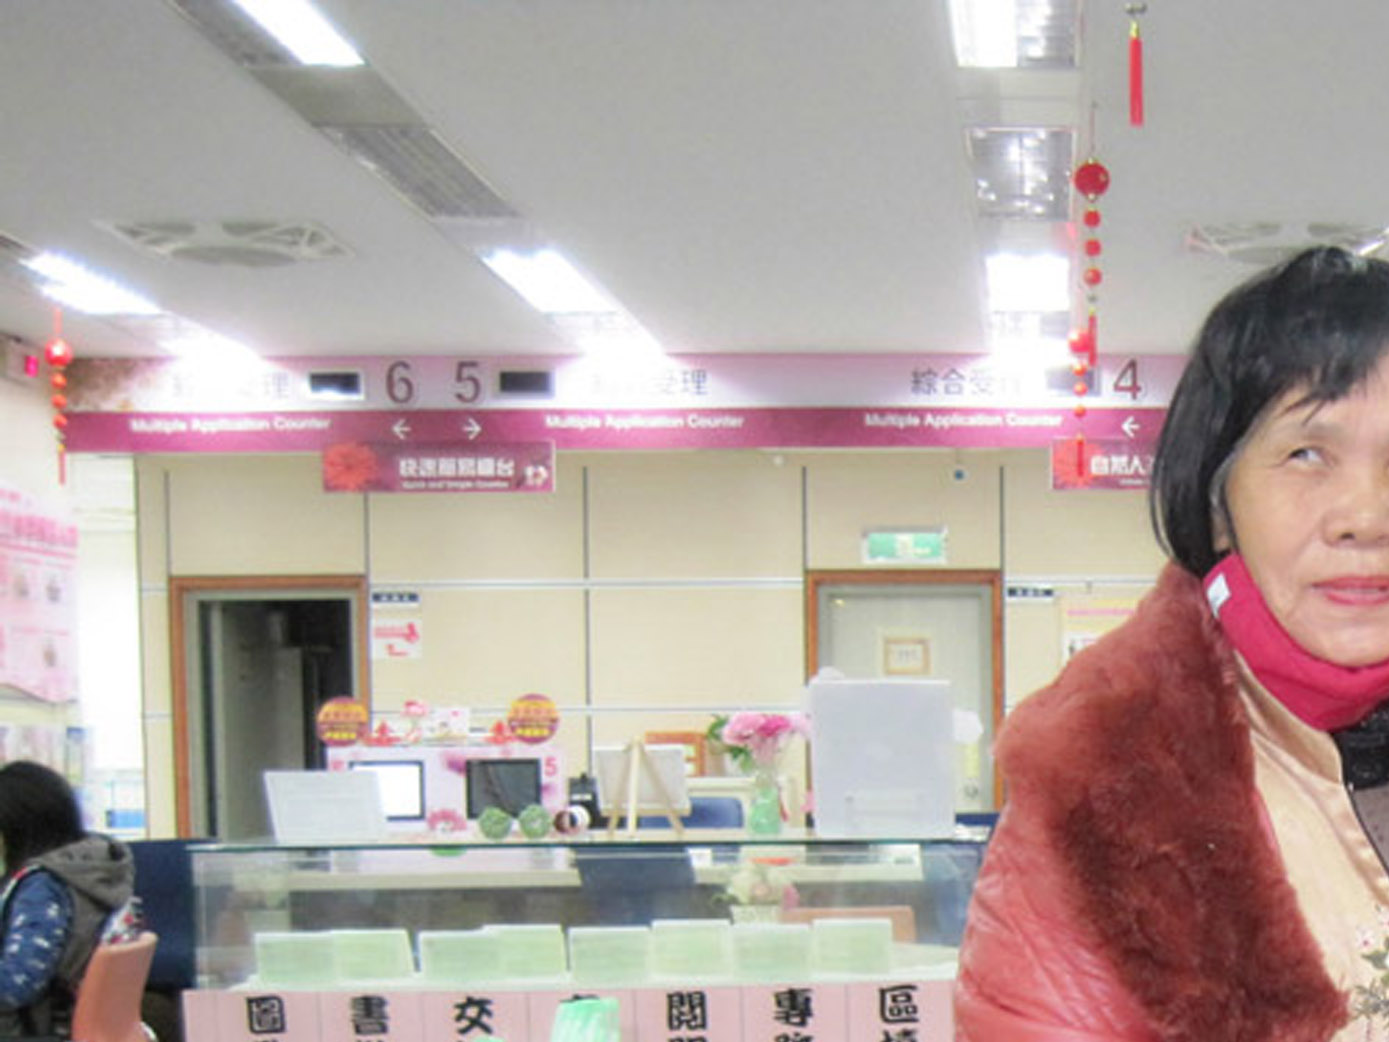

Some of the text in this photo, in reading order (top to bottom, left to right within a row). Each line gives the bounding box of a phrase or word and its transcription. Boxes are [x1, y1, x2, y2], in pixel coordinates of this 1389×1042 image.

[386, 360, 413, 404] 6
[455, 361, 481, 403] 5
[1113, 359, 1142, 400] 4
[130, 416, 332, 434] Multiple Application Counter
[545, 414, 744, 431] Multiple Application Counter
[864, 412, 1064, 428] Multiple Application Counter
